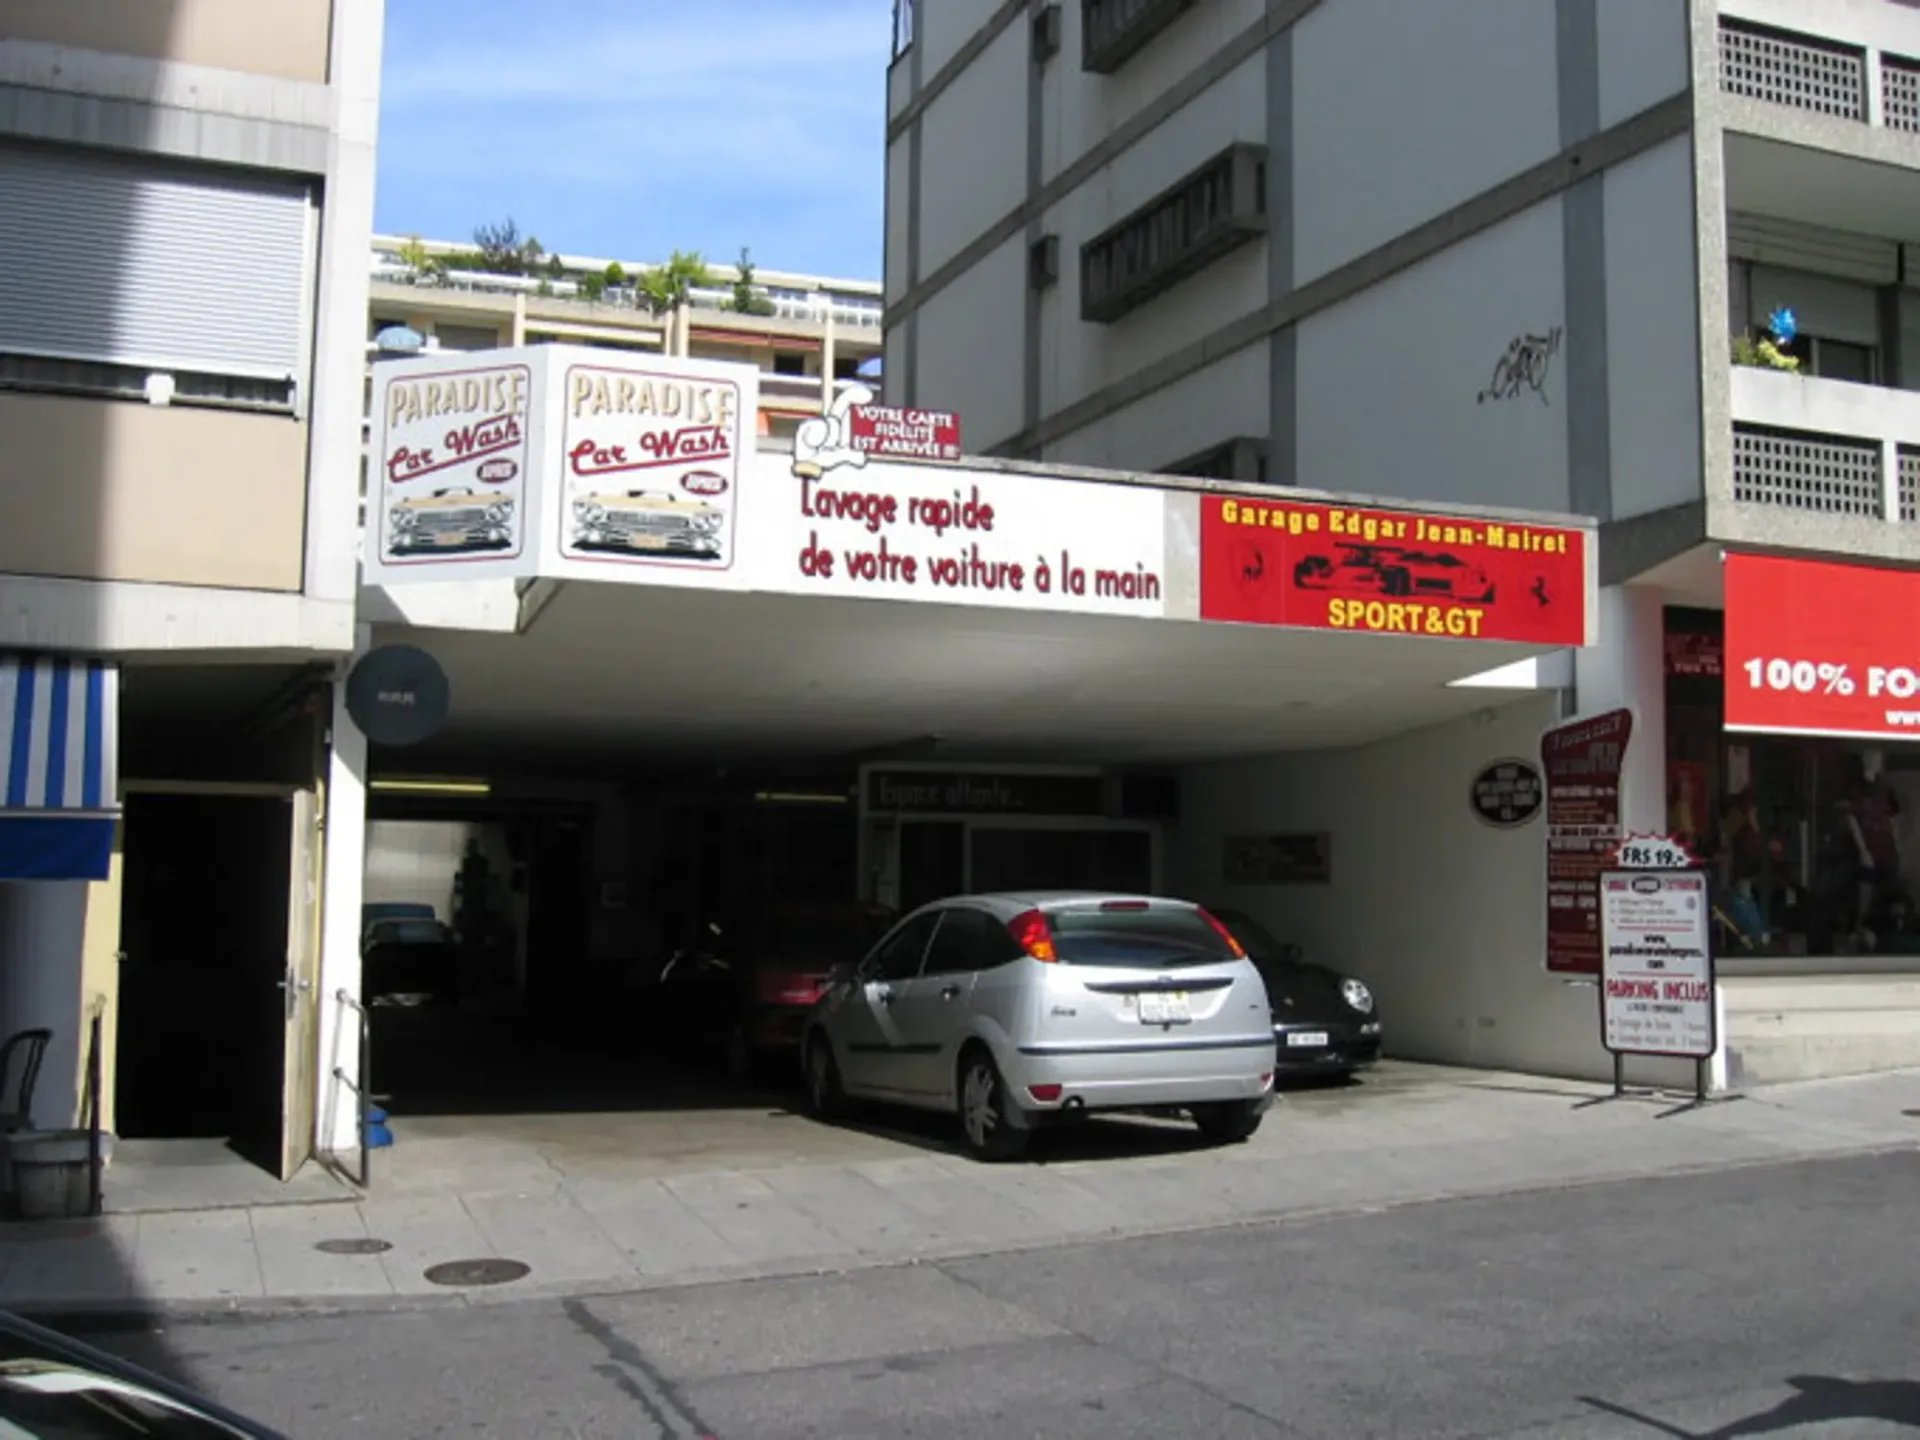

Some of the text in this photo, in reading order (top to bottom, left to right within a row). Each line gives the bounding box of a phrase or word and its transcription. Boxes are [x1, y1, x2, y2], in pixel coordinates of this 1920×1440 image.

[392, 374, 527, 428] PARADISE
[571, 373, 734, 431] PARADISE
[856, 406, 953, 428] VOTRE CARTE
[387, 446, 437, 482] Car
[444, 414, 524, 456] Wash
[568, 425, 730, 475] Car Wash
[853, 435, 878, 451] EST
[801, 475, 995, 536] Lavage rapide
[1221, 500, 1567, 554] Garage Edgar Jean-Mairet
[799, 530, 1161, 600] de votre voiture à la main
[1328, 599, 1483, 636] SPORT&GT
[1744, 657, 1855, 696] 100%
[1867, 666, 1920, 699] FO
[1622, 847, 1650, 865] FRS
[1606, 978, 1659, 1000] PARKING
